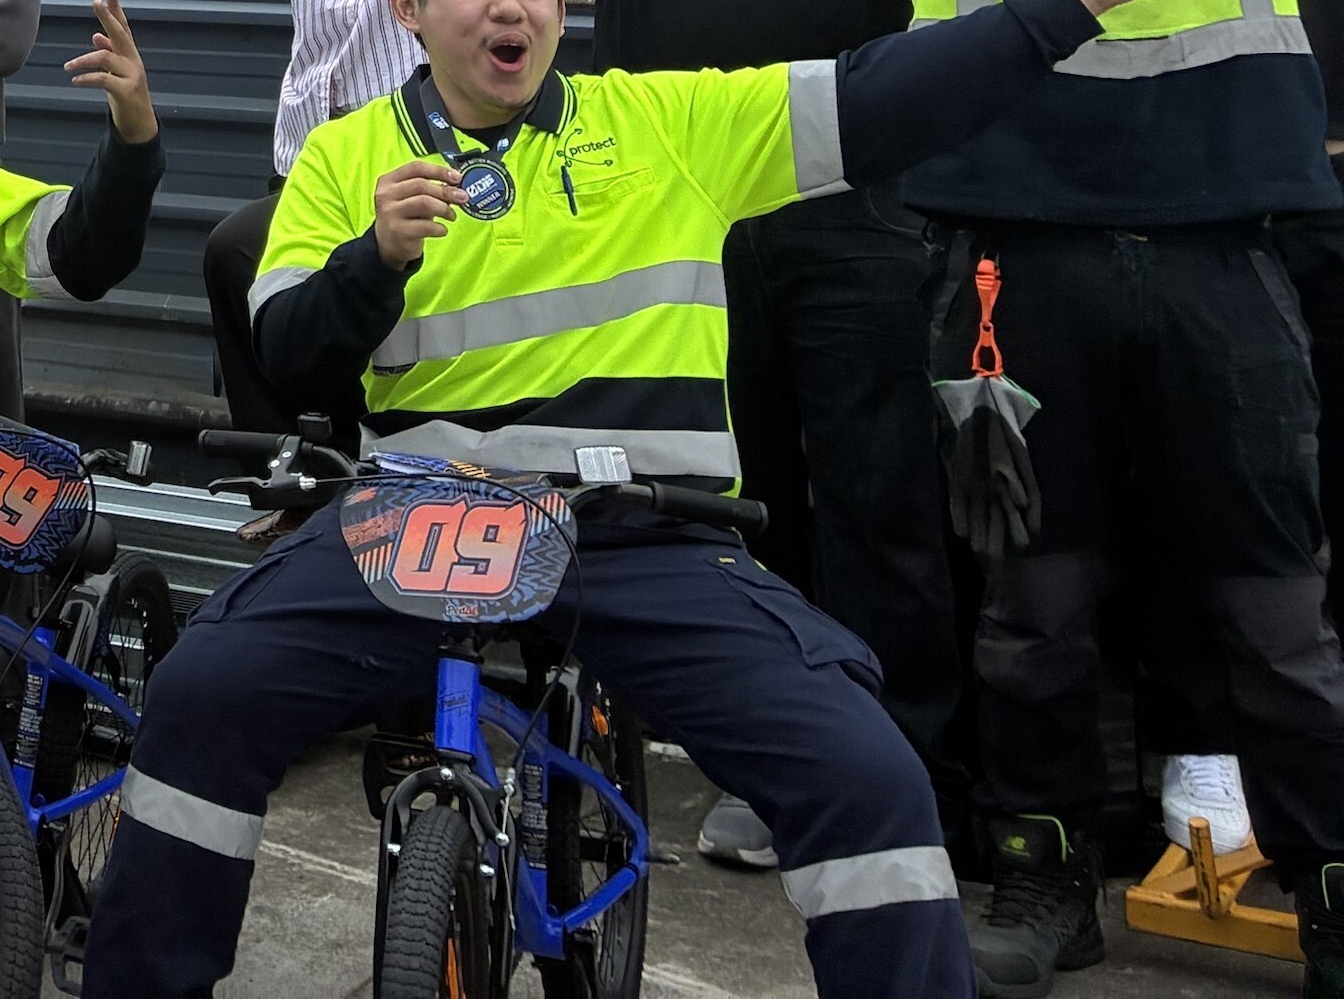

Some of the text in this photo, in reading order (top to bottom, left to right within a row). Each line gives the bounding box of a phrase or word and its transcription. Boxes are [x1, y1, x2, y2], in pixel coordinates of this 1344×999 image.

[569, 136, 617, 157] protect
[392, 501, 528, 594] 09
[445, 603, 479, 617] Pedal
